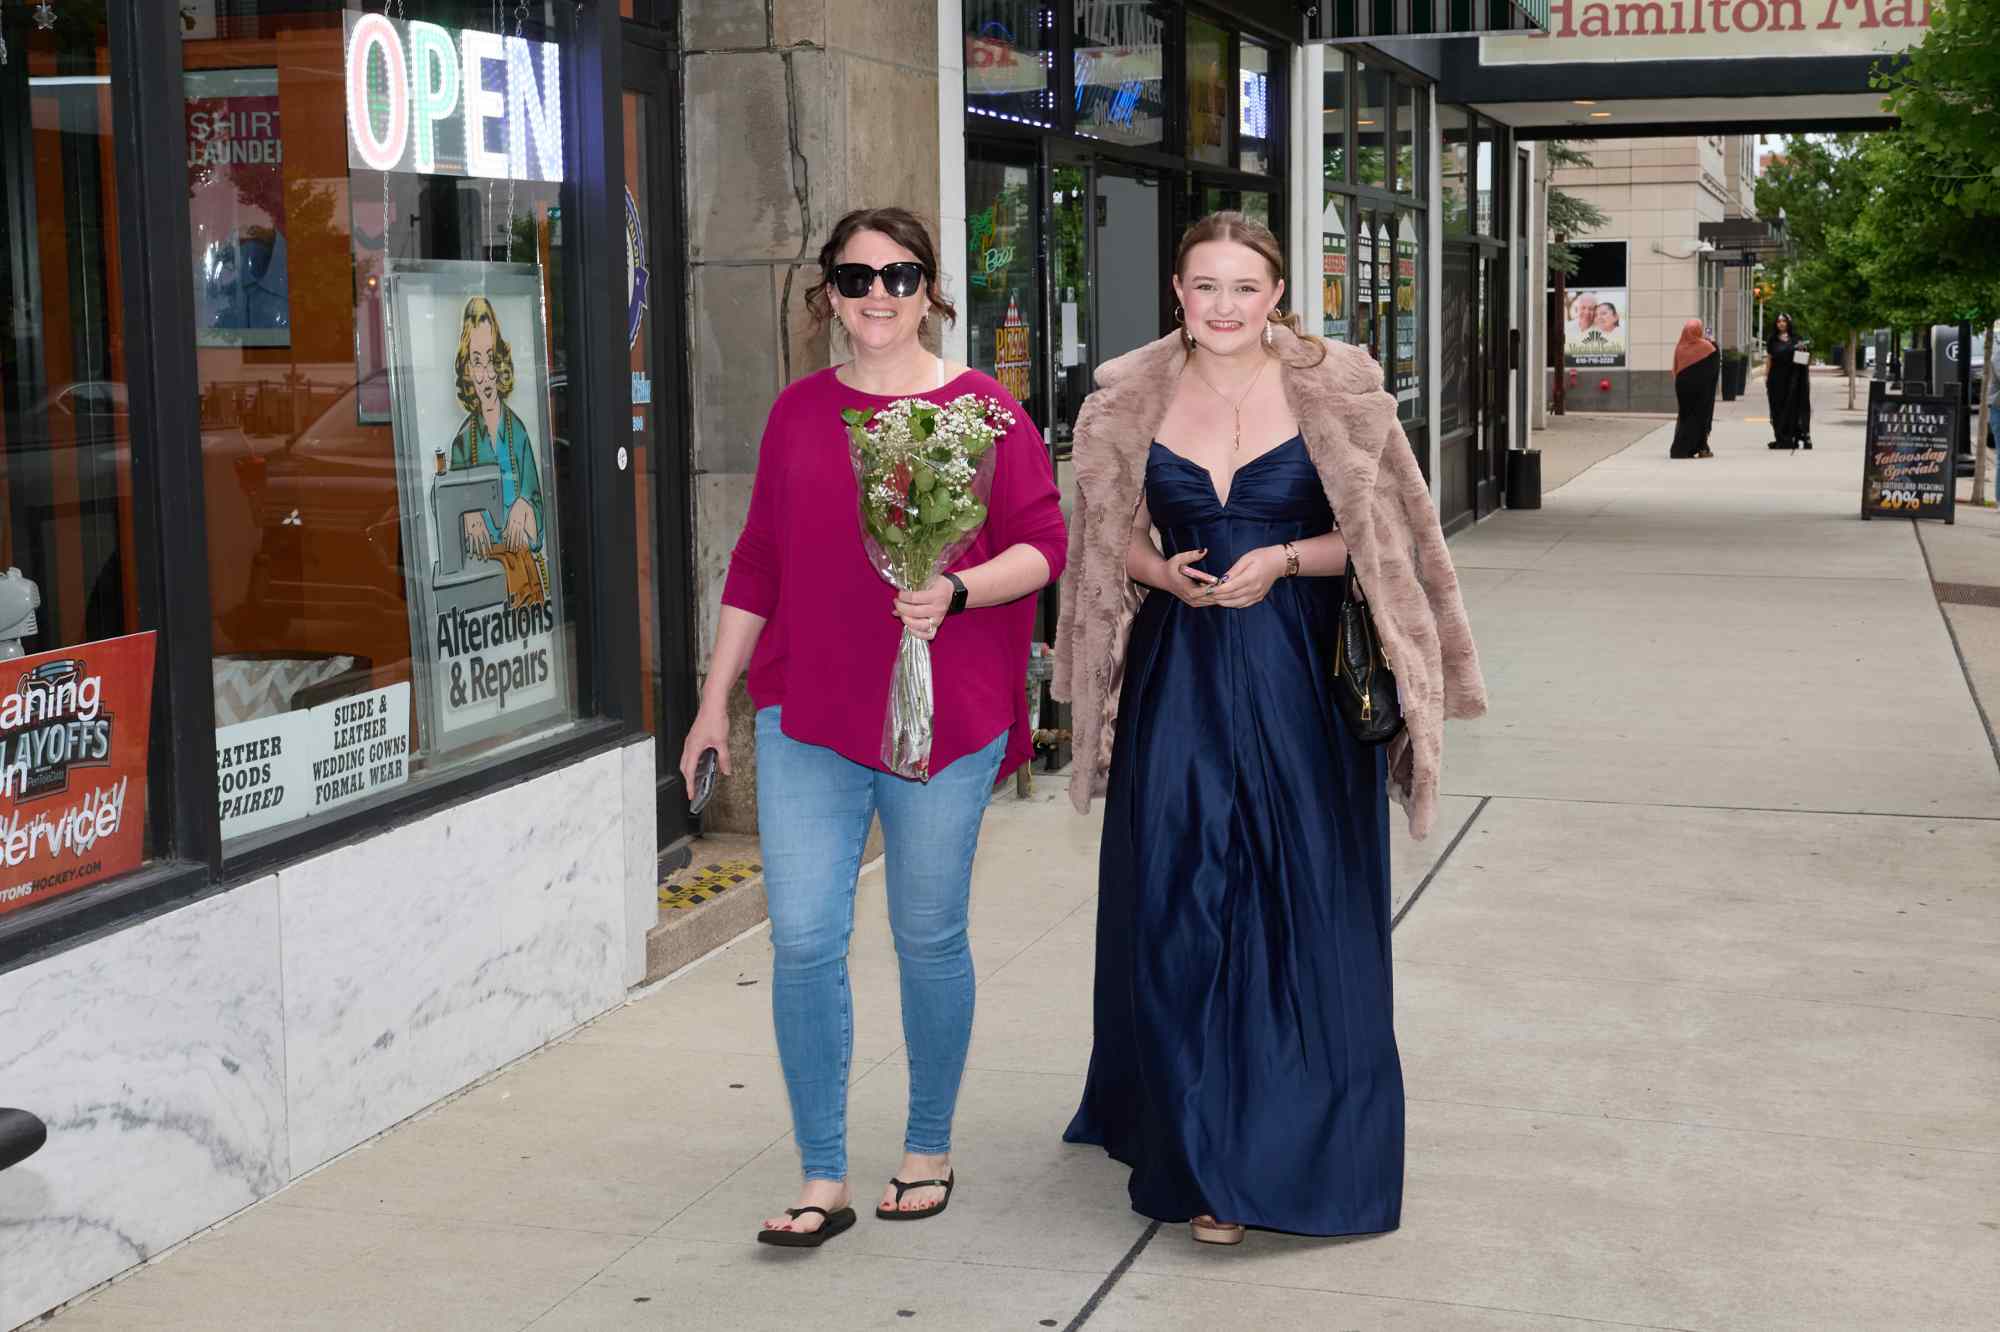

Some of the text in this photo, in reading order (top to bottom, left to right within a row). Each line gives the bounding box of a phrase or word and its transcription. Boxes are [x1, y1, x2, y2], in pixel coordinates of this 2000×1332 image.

[346, 12, 563, 182] OPEN
[1886, 423, 1939, 434] TATTOO
[1874, 448, 1947, 465] Tattoosday
[1884, 461, 1939, 481] Specials
[1880, 489, 1944, 509] 20% OFF
[437, 597, 554, 660] Alterations
[450, 640, 548, 709] & Repairs
[334, 694, 387, 727] SUEDE &
[334, 717, 386, 750] LEATHER
[312, 735, 406, 782] WEDDING GOWNS
[315, 759, 403, 806] FORMAL WEAR
[217, 785, 284, 821] PAIRED
[0, 860, 102, 903] TOMSHOCKEY.COM
